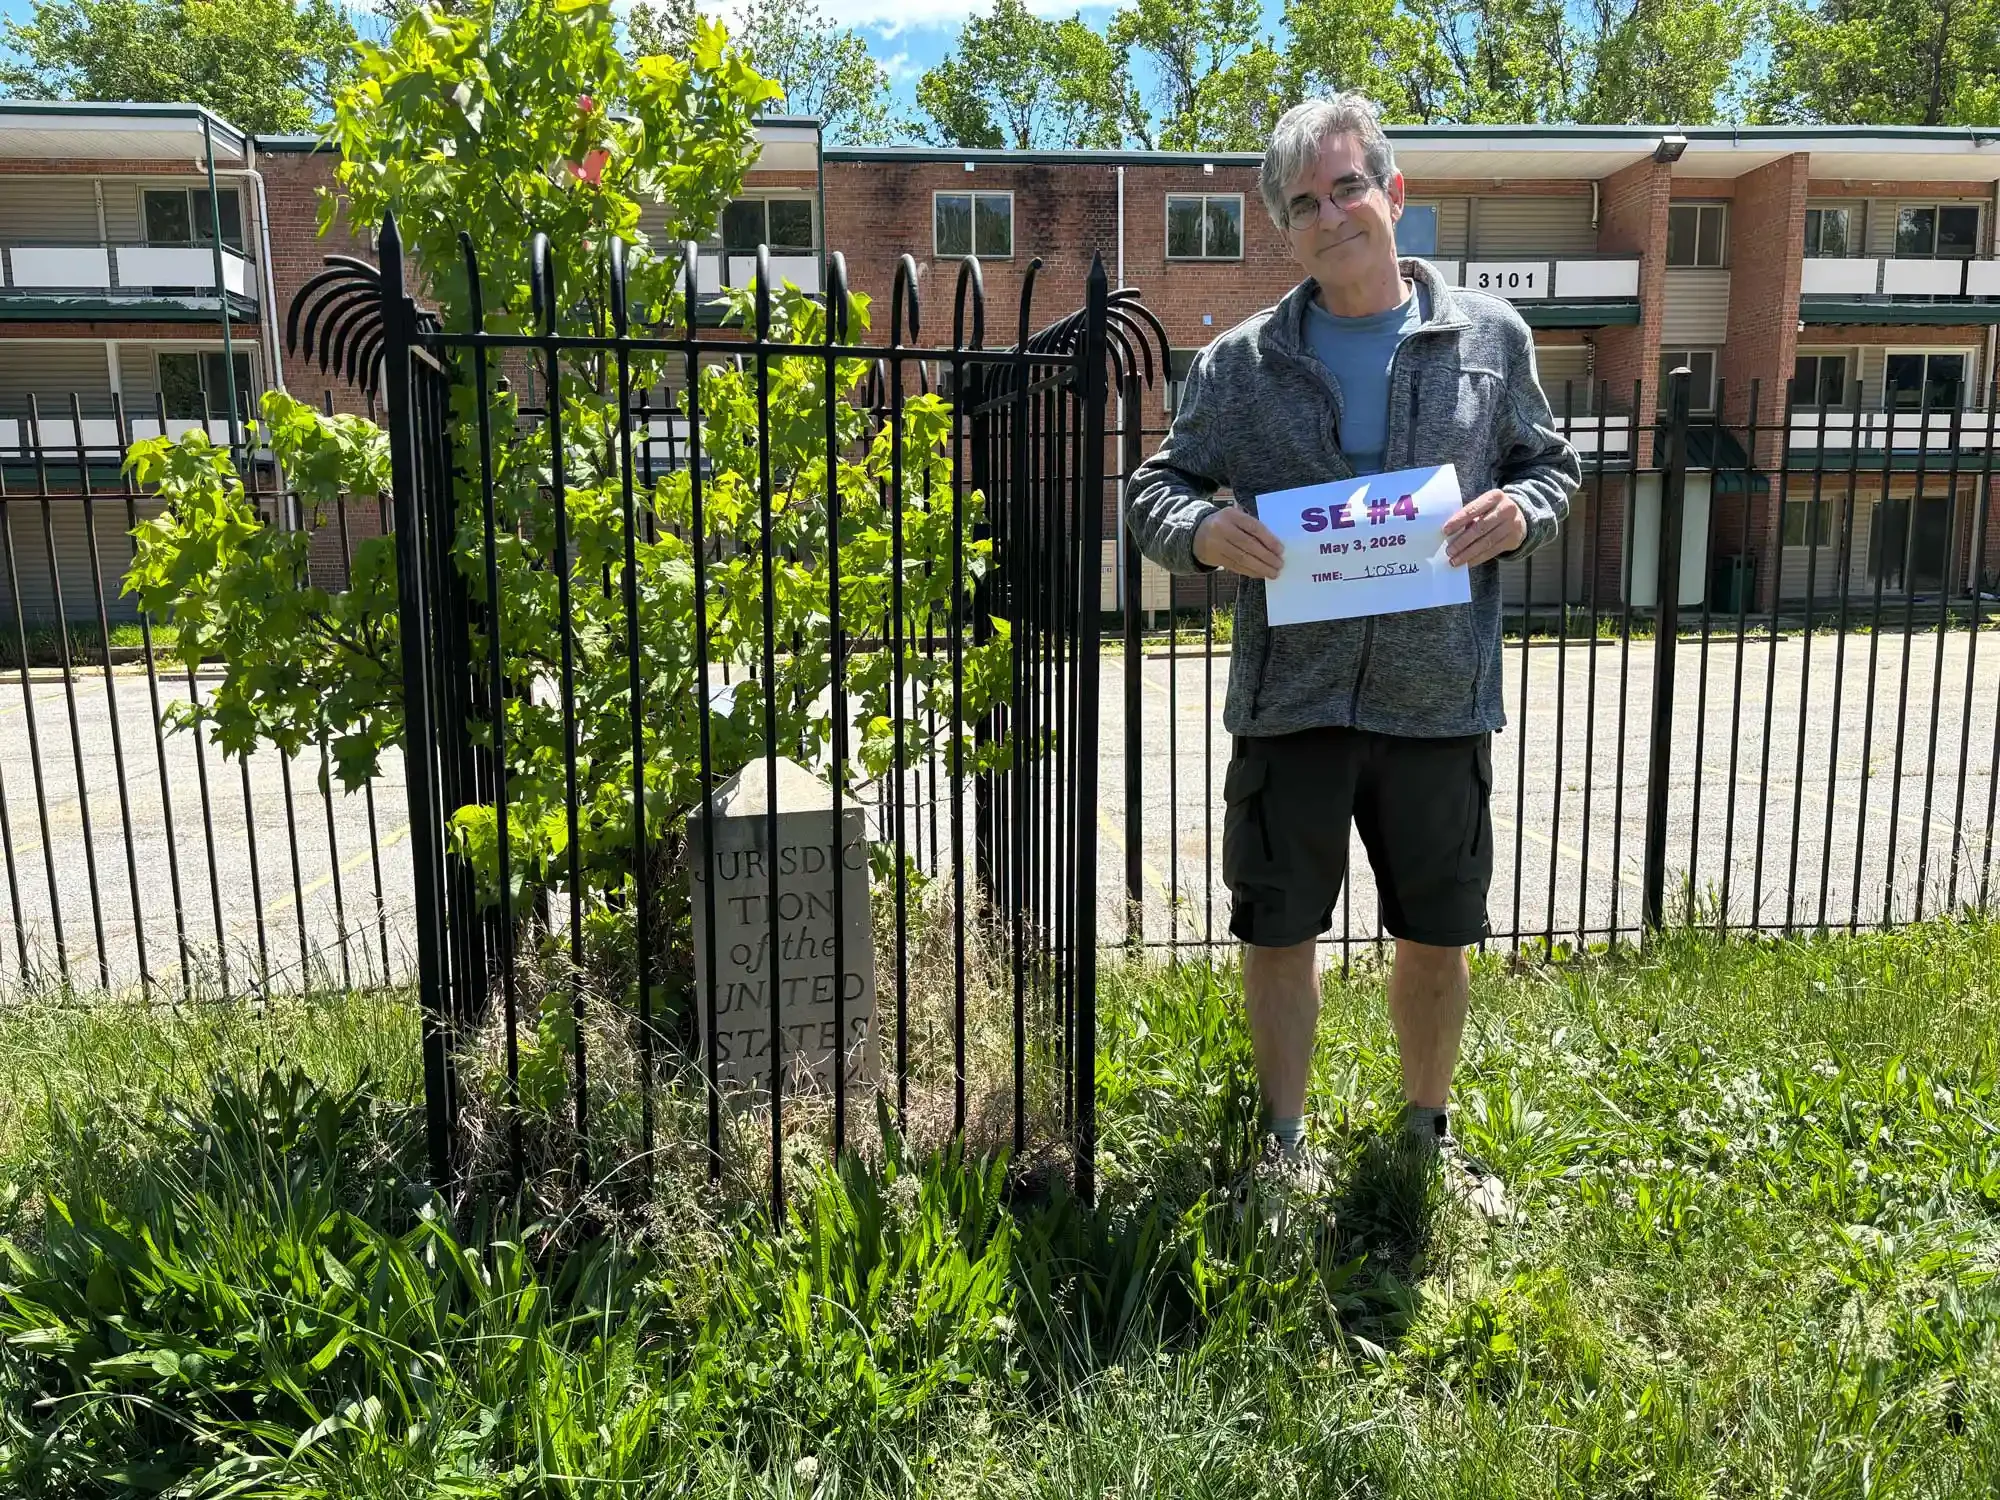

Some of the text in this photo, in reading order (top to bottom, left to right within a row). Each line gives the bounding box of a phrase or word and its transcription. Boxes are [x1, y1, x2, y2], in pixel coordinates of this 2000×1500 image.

[1479, 273, 1533, 288] 3101
[1301, 494, 1419, 532] SE #4
[1319, 534, 1407, 555] May 3, 2026
[1312, 571, 1343, 583] TIME:
[1364, 562, 1398, 577] 1:05
[731, 926, 835, 973] of the
[716, 973, 864, 1014] UNTED
